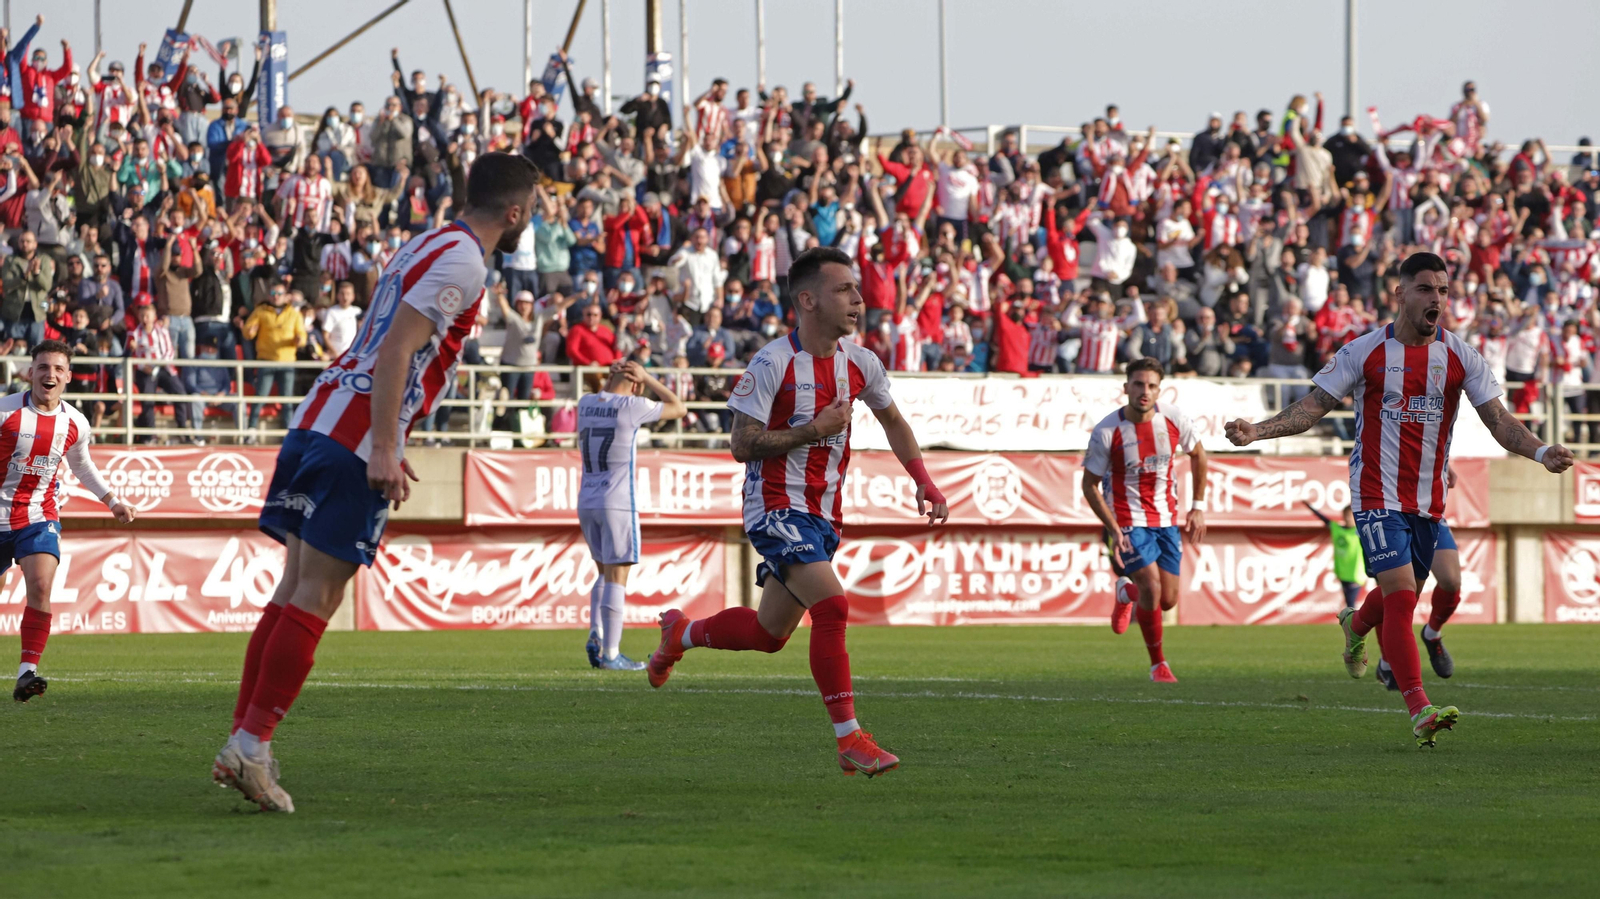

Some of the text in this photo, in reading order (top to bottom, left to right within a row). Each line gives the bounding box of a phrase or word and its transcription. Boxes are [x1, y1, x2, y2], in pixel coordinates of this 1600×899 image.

[1408, 395, 1445, 411] 威视
[579, 427, 615, 473] 17
[187, 470, 264, 487] COSCO
[190, 487, 261, 498] SHIPPING
[1361, 521, 1388, 552] 11
[781, 543, 815, 557] GIVOVA
[924, 532, 1111, 573] HYUNDAI
[200, 536, 285, 609] 40
[924, 572, 1112, 595] PERMOTOR
[472, 605, 553, 624] BOUTIQUE
[556, 605, 577, 624] DE
